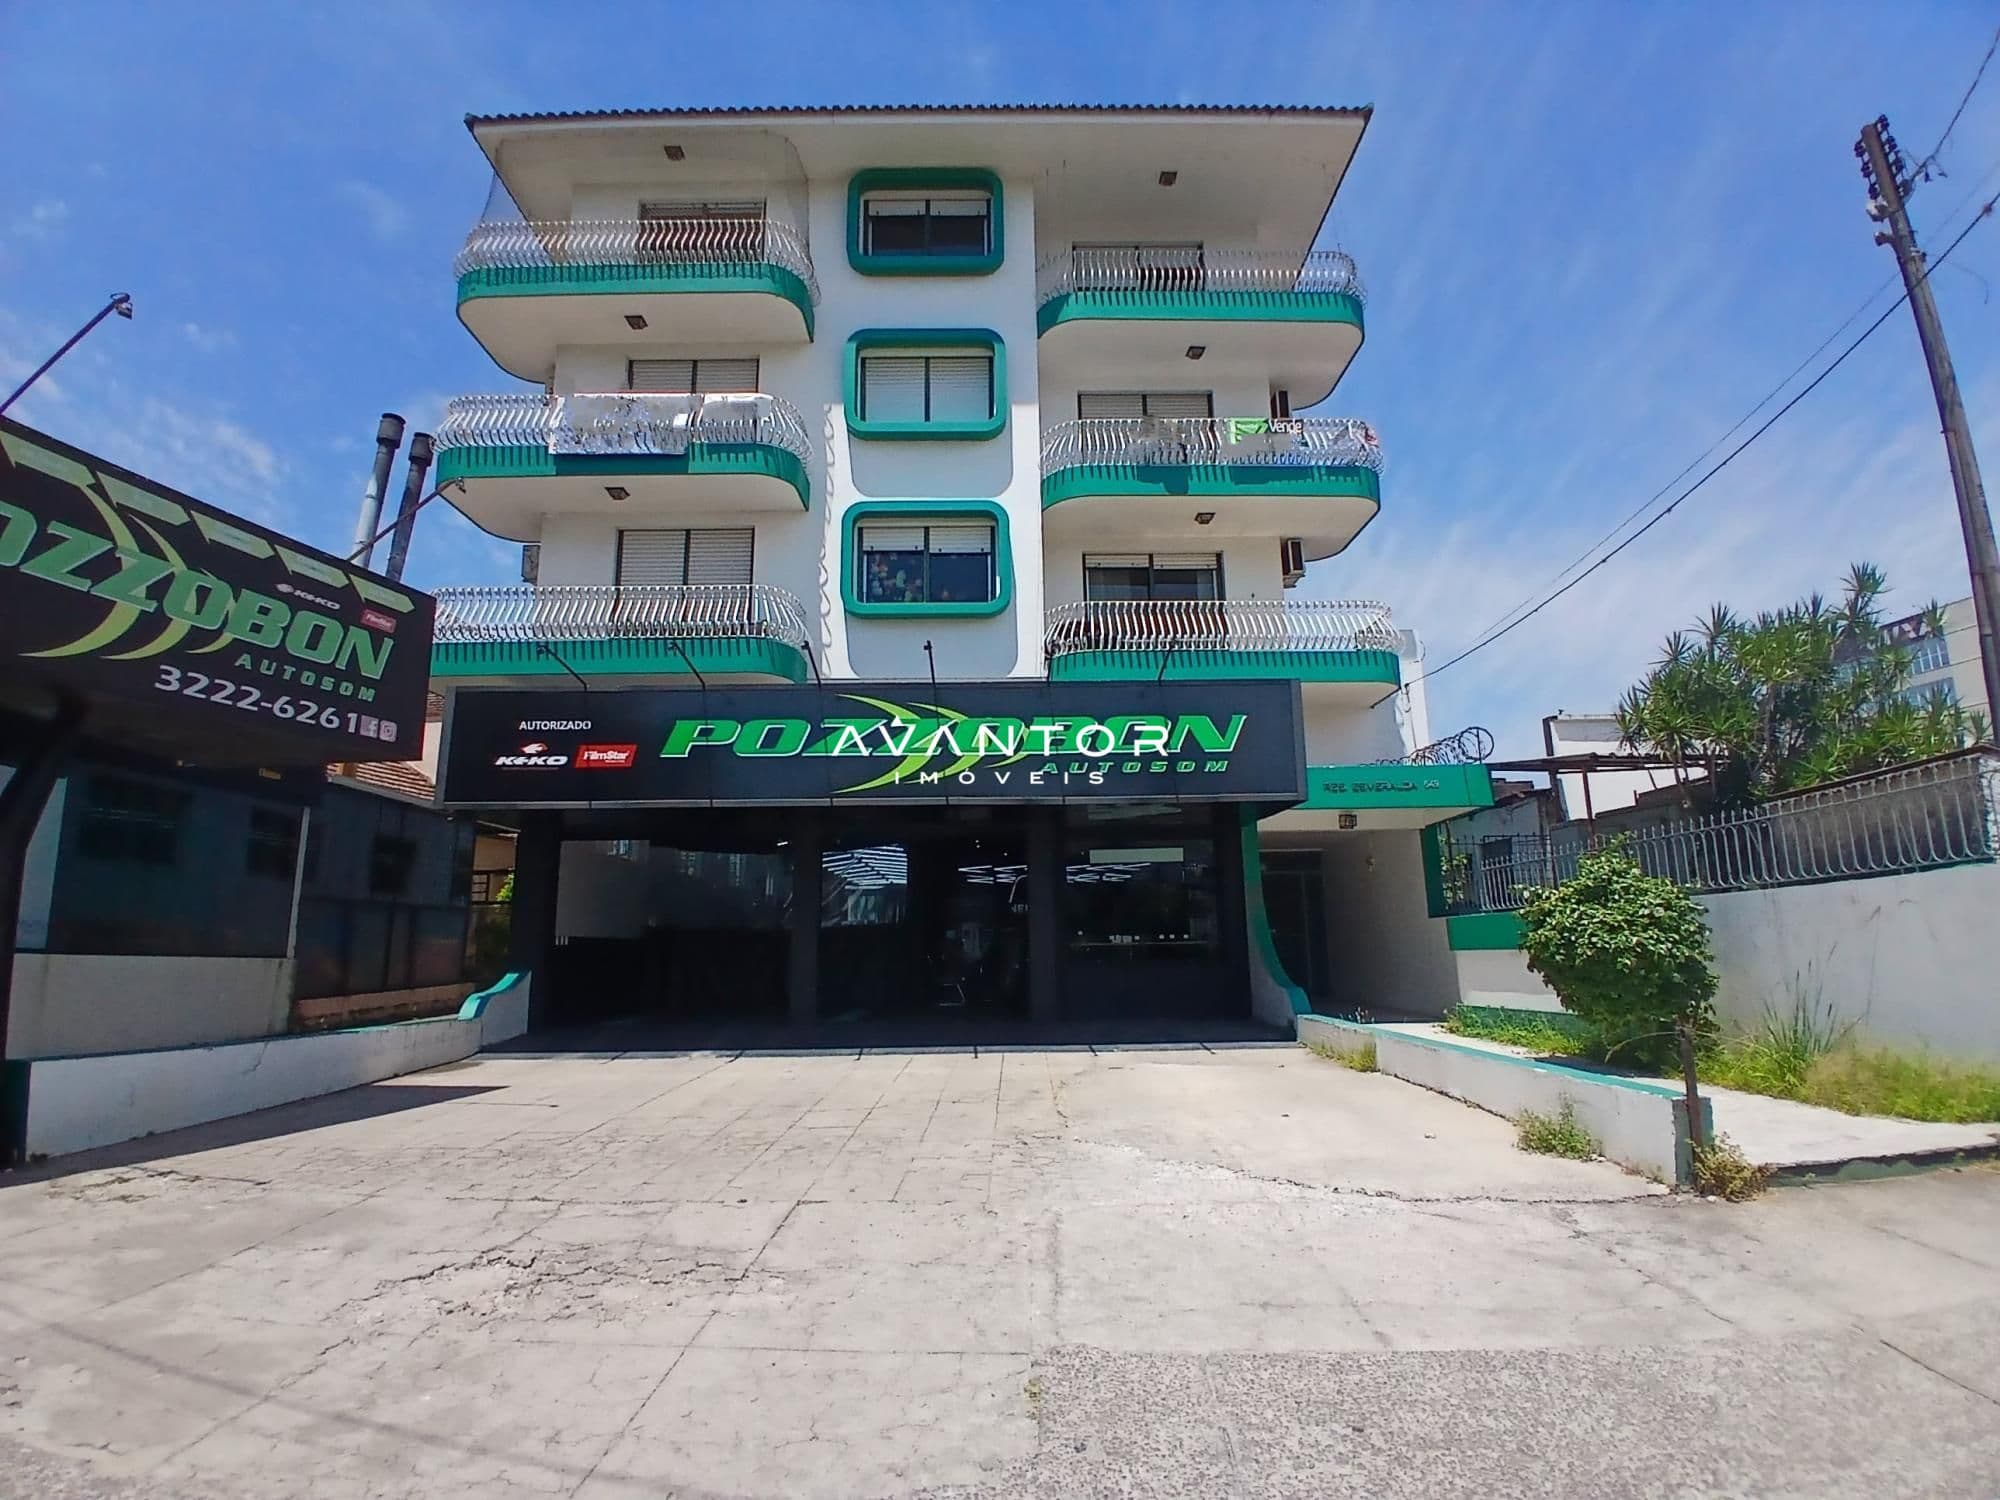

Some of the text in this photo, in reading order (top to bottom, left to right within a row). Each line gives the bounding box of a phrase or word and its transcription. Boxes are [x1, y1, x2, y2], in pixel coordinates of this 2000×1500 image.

[1268, 418, 1303, 433] Vende
[234, 653, 376, 703] AUTOSOM
[154, 665, 358, 734] 3222-6261
[518, 720, 592, 731] AUTORIZADO
[659, 714, 1248, 758] POZZOBON
[583, 750, 631, 761] FilmStar
[1040, 760, 1229, 774] AUTOSOM
